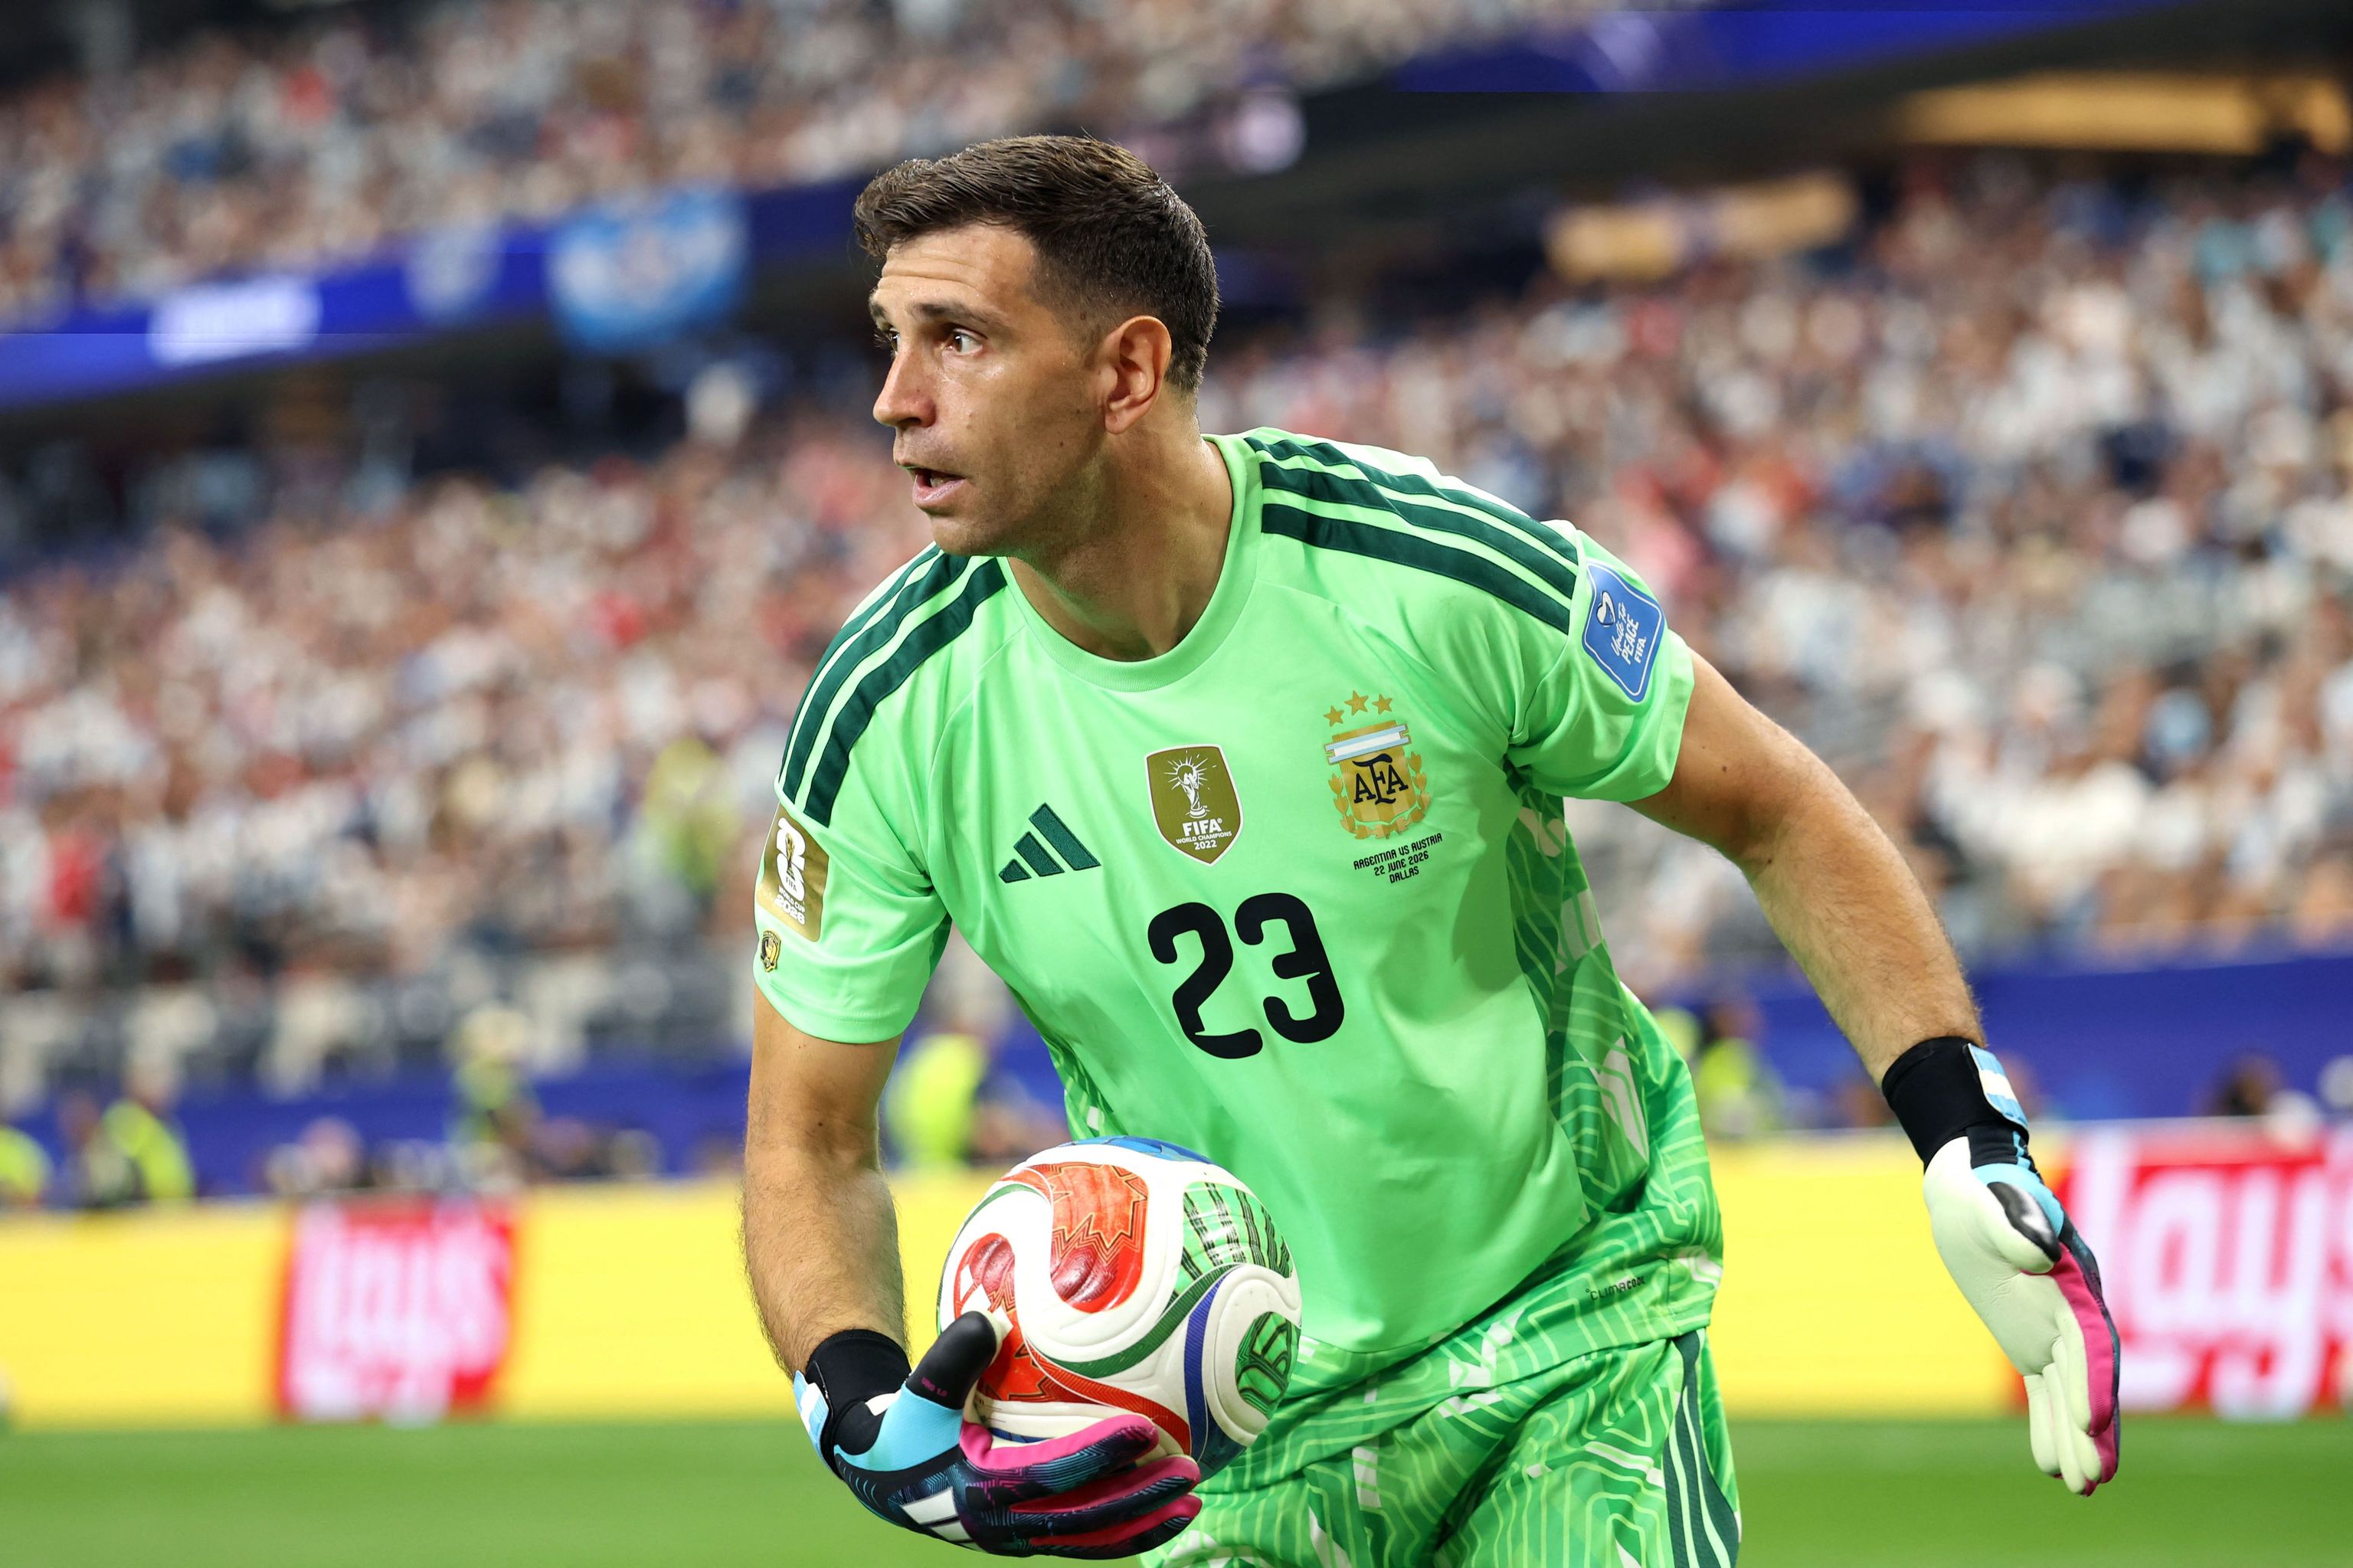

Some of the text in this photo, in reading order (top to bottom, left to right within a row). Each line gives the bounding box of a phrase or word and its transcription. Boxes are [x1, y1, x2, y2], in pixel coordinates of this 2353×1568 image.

[1622, 614, 1639, 665] PEACE
[1634, 637, 1646, 663] FIFA
[1352, 753, 1409, 805] AFA
[1182, 818, 1222, 836] FIFA
[1198, 831, 1232, 840] CHAMPIONS
[1193, 840, 1217, 850] 2022
[1353, 833, 1443, 870] ARGENTINA VS AUSTRIA
[1373, 850, 1429, 876] 22 JUNE 2026
[1389, 866, 1419, 884] DALLAS
[774, 894, 806, 925] 2026
[794, 901, 806, 913] CUP
[1147, 892, 1345, 1059] 23
